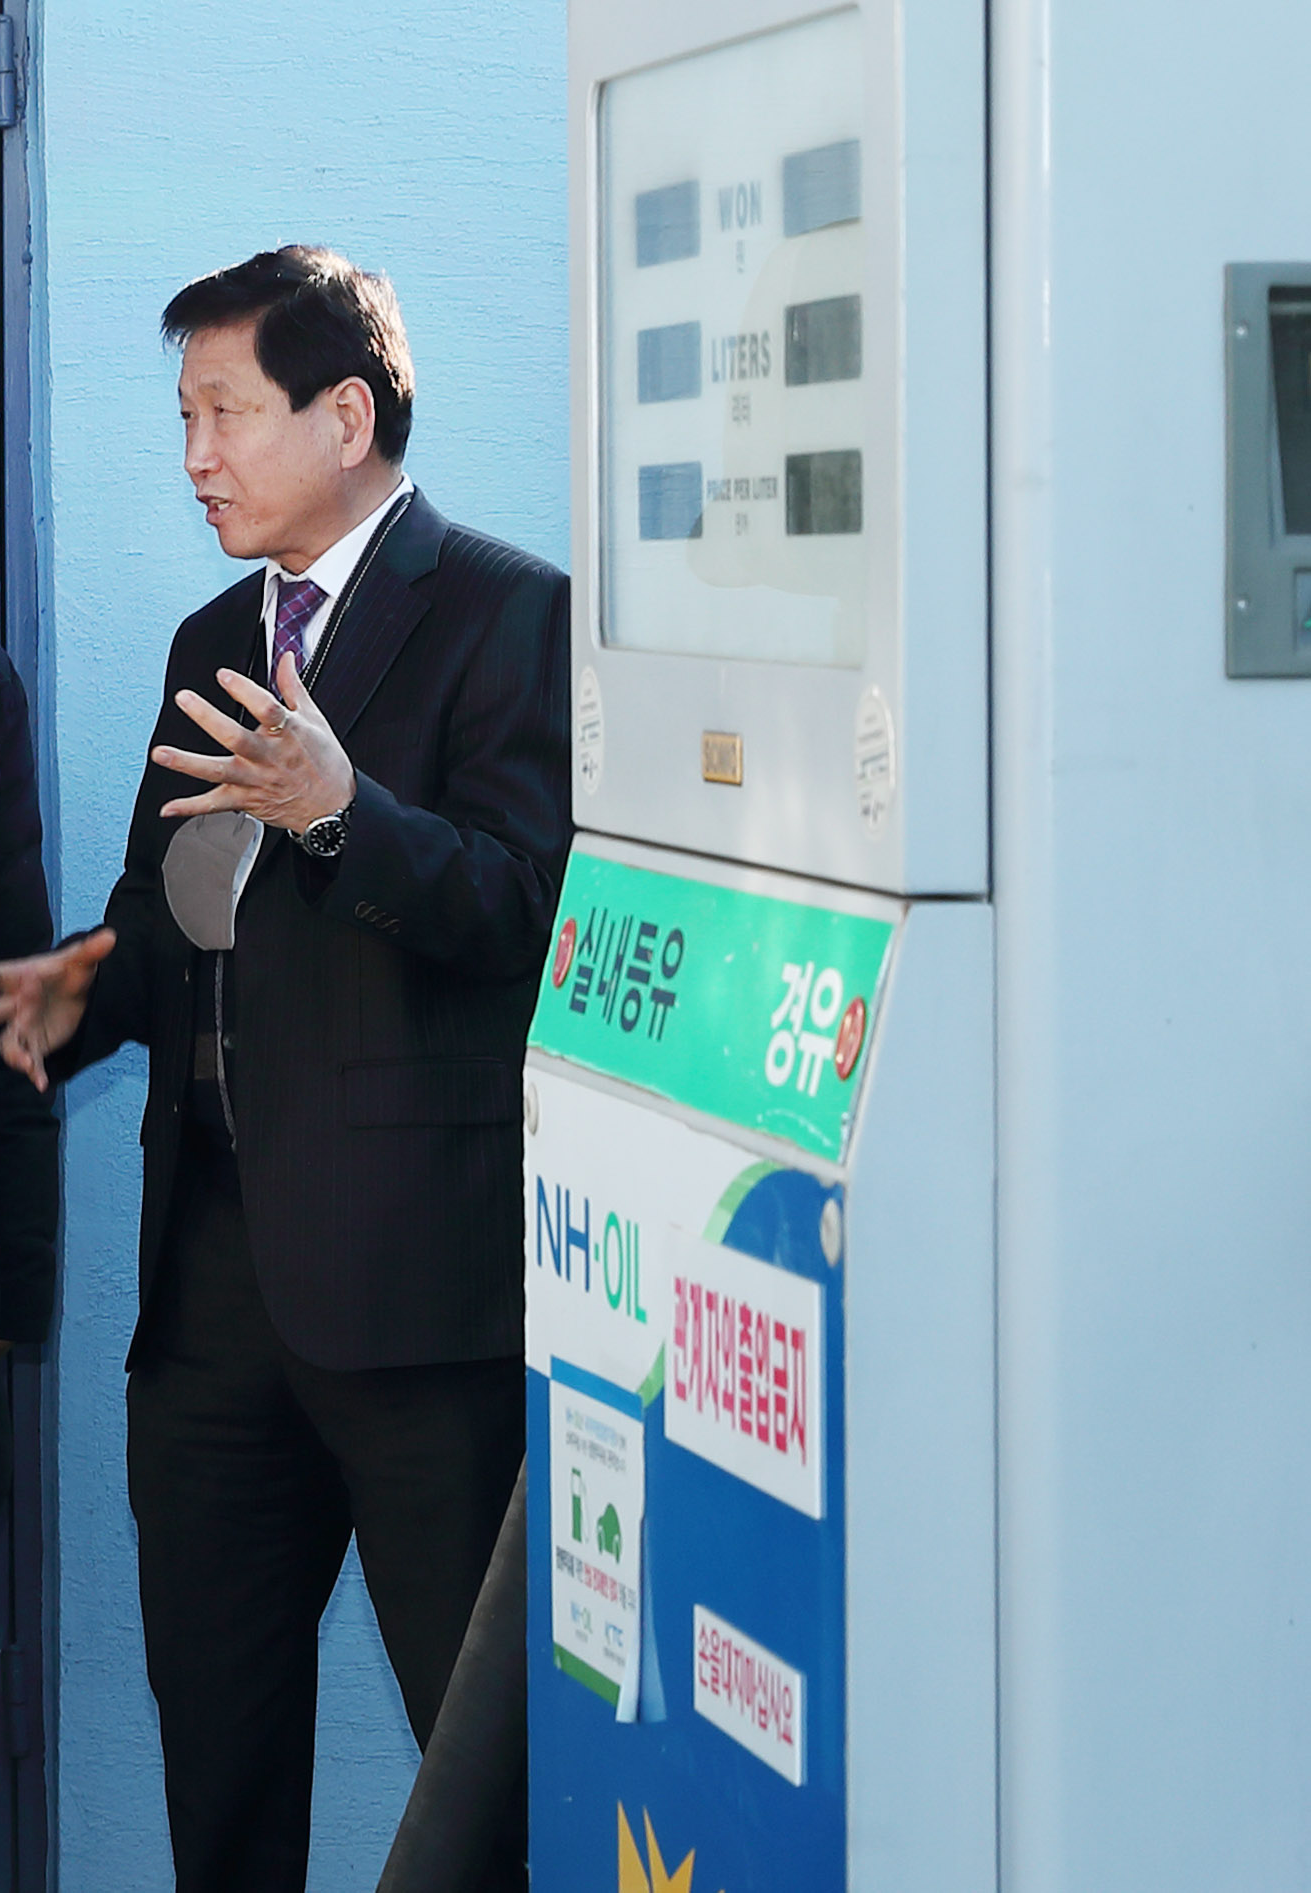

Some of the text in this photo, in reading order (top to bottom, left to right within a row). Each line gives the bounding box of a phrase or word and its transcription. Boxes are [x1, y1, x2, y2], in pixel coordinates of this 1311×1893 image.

[718, 181, 762, 232] WON
[711, 330, 772, 383] LITERS
[752, 474, 778, 500] LITER
[570, 906, 685, 1042] 실내등유
[765, 961, 844, 1097] 경유
